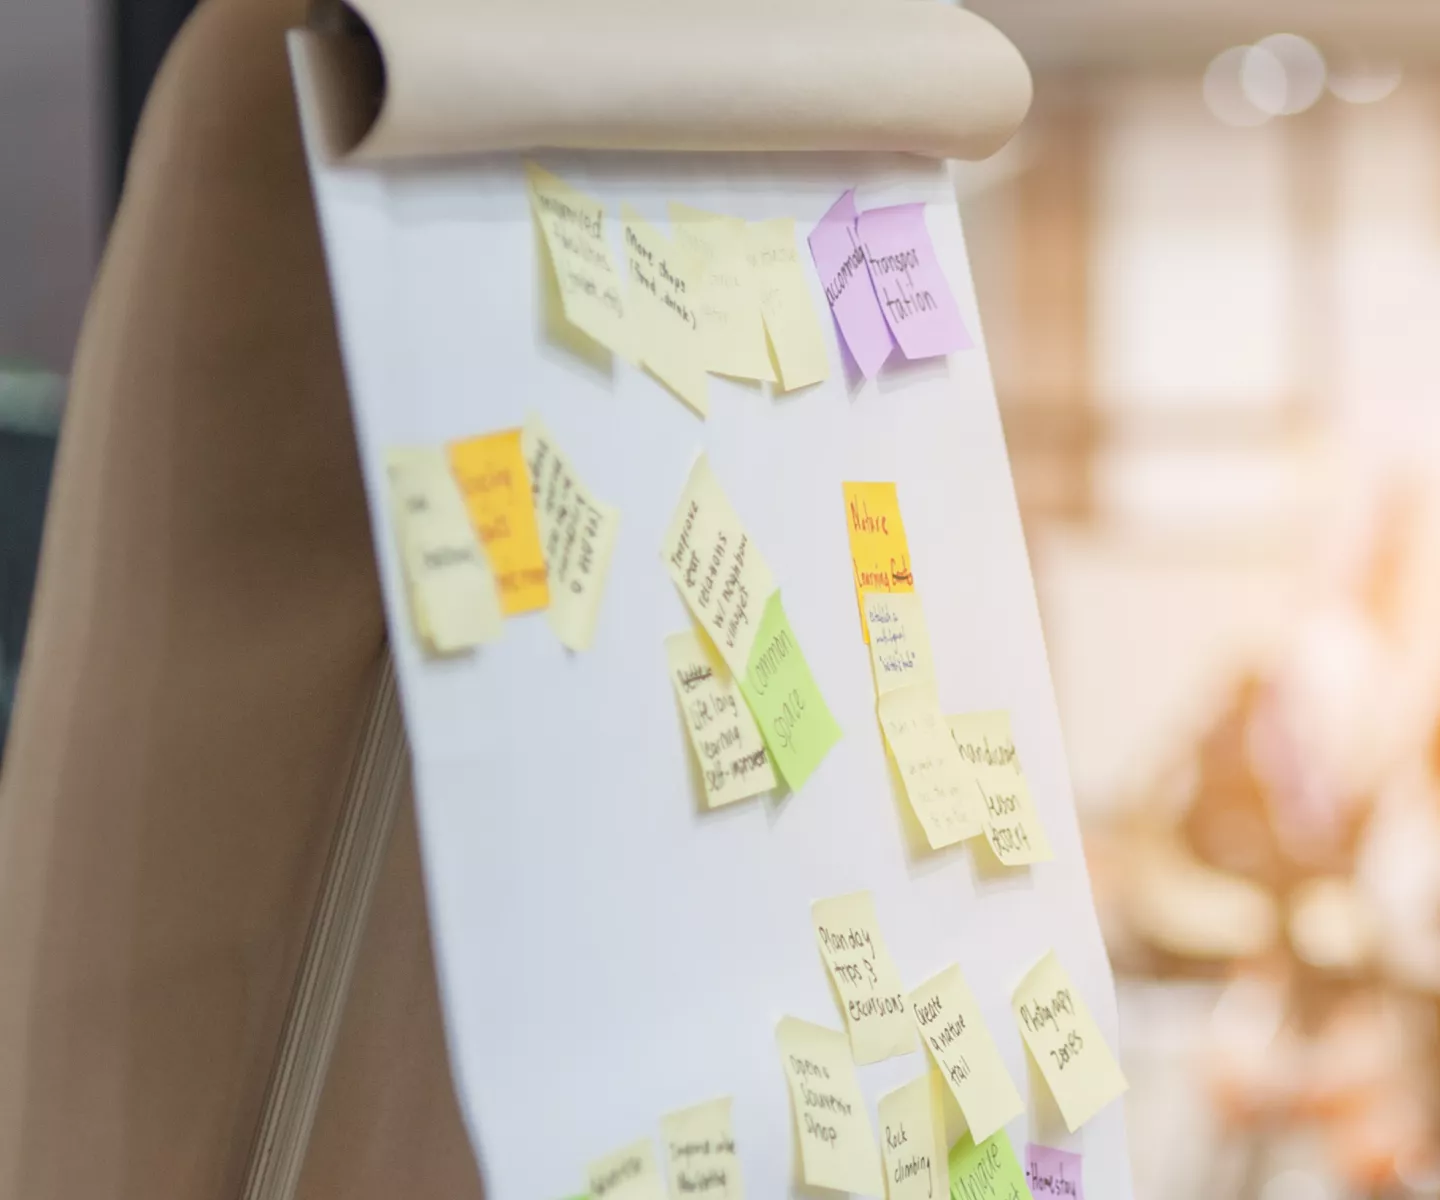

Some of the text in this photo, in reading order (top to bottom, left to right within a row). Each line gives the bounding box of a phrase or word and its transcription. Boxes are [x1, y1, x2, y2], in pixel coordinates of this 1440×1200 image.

[882, 278, 937, 324] tation
[773, 688, 806, 753] space
[818, 926, 876, 960] Plan day
[834, 962, 863, 988] trips
[848, 993, 904, 1022] excursions
[913, 995, 943, 1026] Create
[938, 1013, 967, 1049] nature
[942, 1054, 972, 1087] trail
[885, 1122, 908, 1152] Rock
[894, 1155, 933, 1199] climbing
